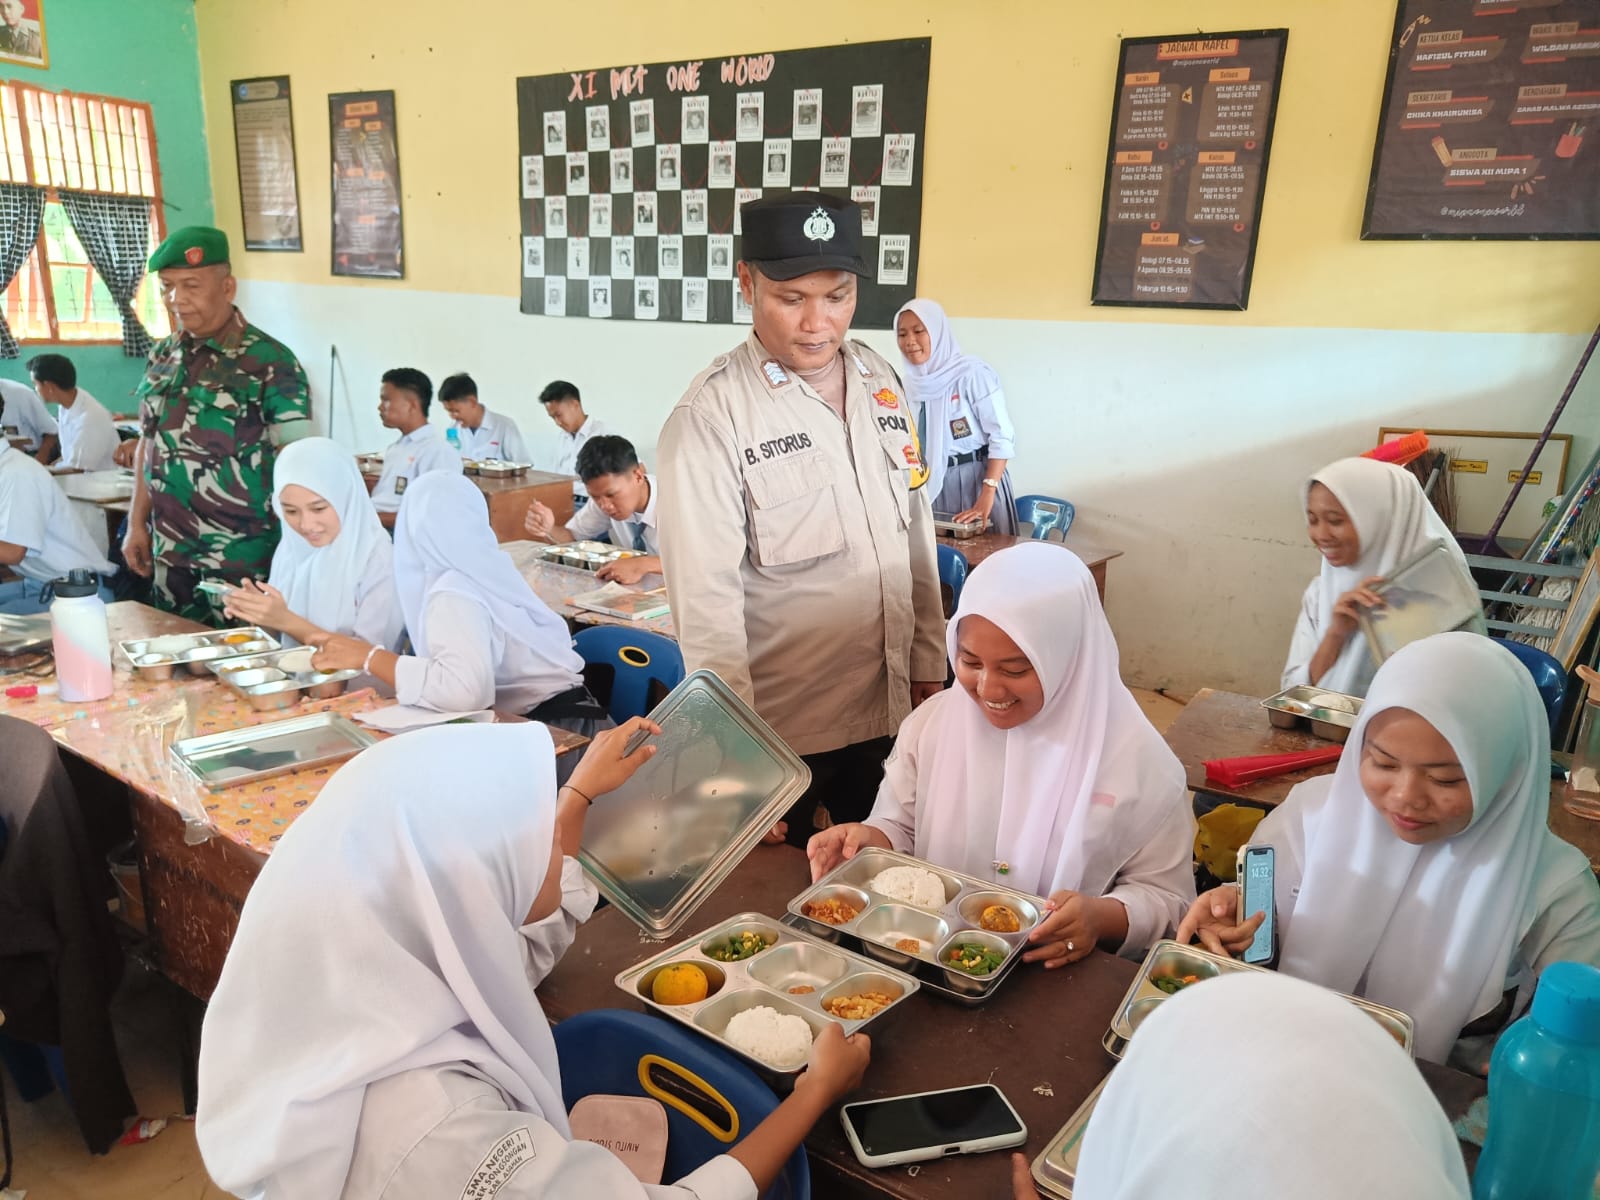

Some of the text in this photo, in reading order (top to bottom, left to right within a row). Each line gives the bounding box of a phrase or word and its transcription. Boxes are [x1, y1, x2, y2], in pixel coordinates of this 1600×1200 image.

[1166, 40, 1229, 54] JADWAL MAPEL
[665, 60, 704, 92] ONE
[744, 431, 813, 466] B. SITORUS
[466, 1133, 521, 1197] SMA NEGERI 1
[485, 1142, 527, 1185] SONGSONGAN
[502, 1156, 523, 1179] ASAHAN
